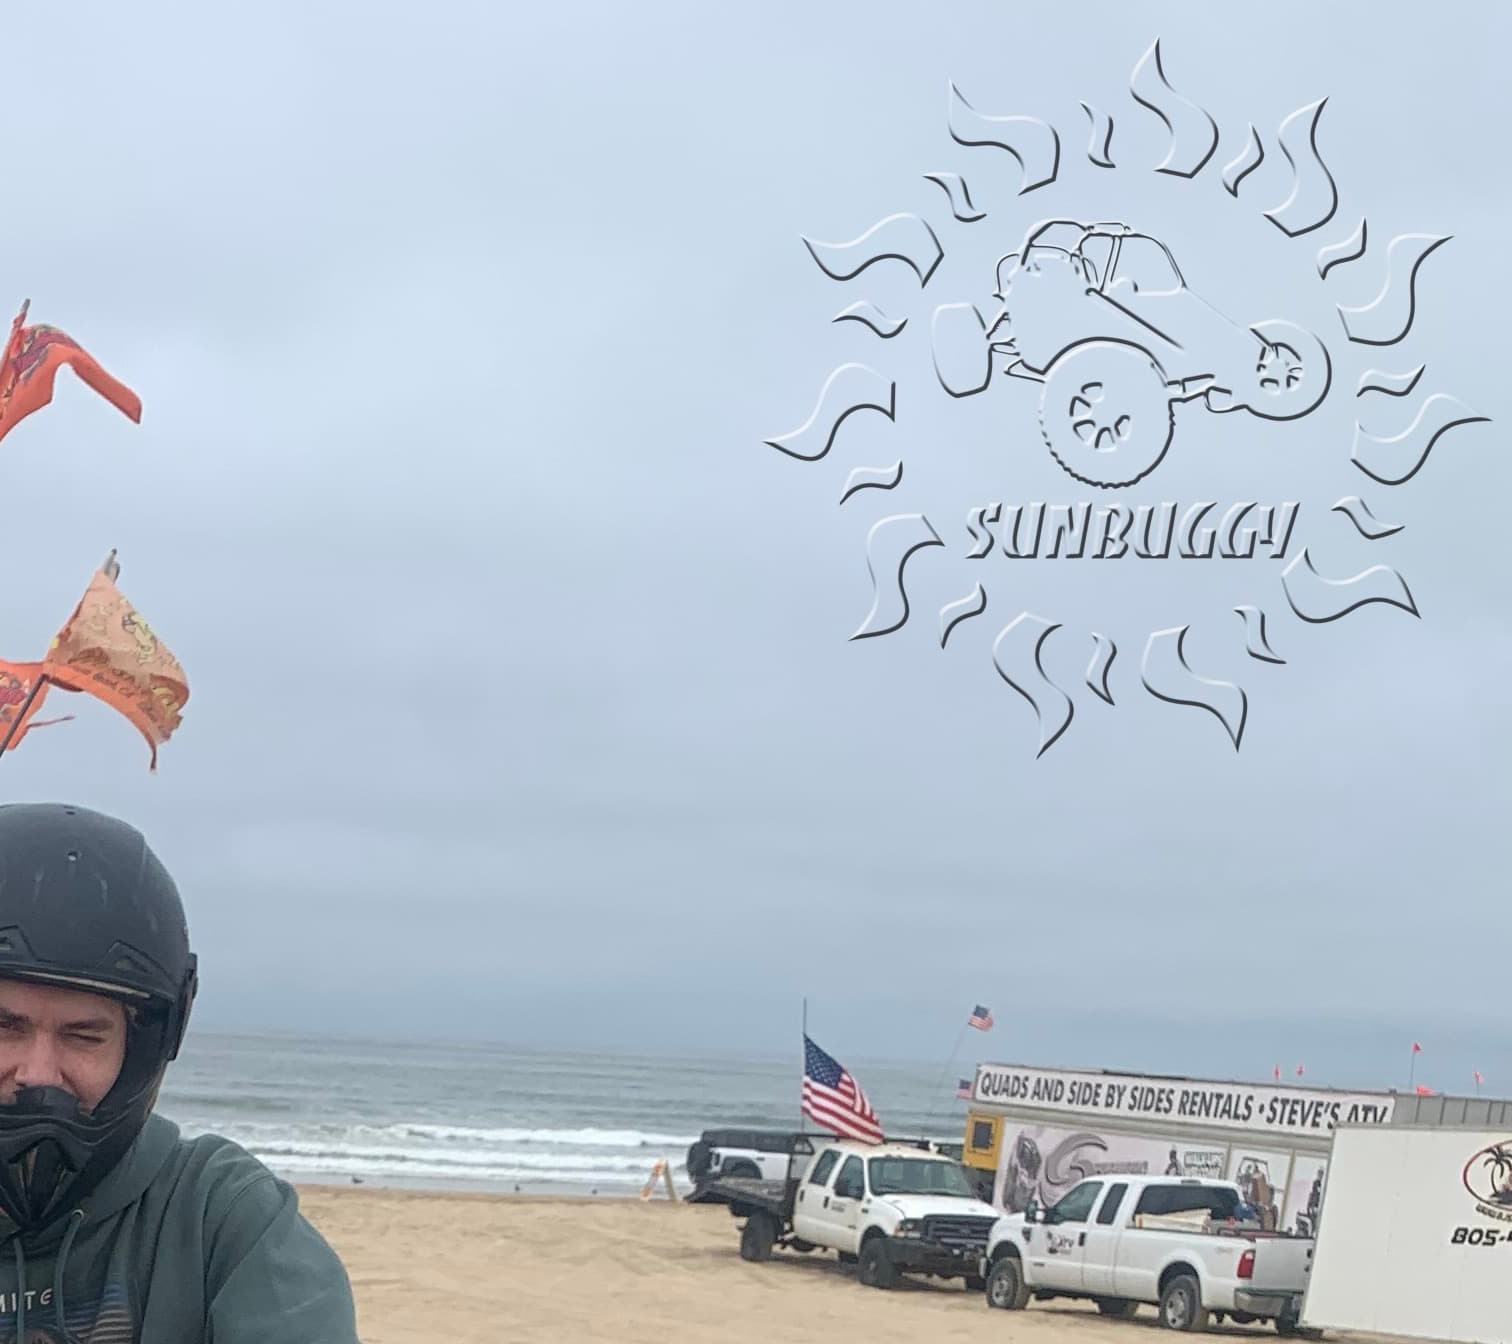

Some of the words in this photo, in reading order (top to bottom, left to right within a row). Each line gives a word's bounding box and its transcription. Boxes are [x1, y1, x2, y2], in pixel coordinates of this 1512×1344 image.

[981, 1072, 1029, 1099] QUADS
[1031, 1077, 1064, 1102] AND
[1067, 1080, 1102, 1107] SIDE
[1104, 1084, 1126, 1109] BY
[1127, 1085, 1175, 1114] SIDES
[1177, 1088, 1254, 1121] RENTALS
[1266, 1096, 1341, 1129] STEVE'S
[1347, 1104, 1388, 1124] ATV
